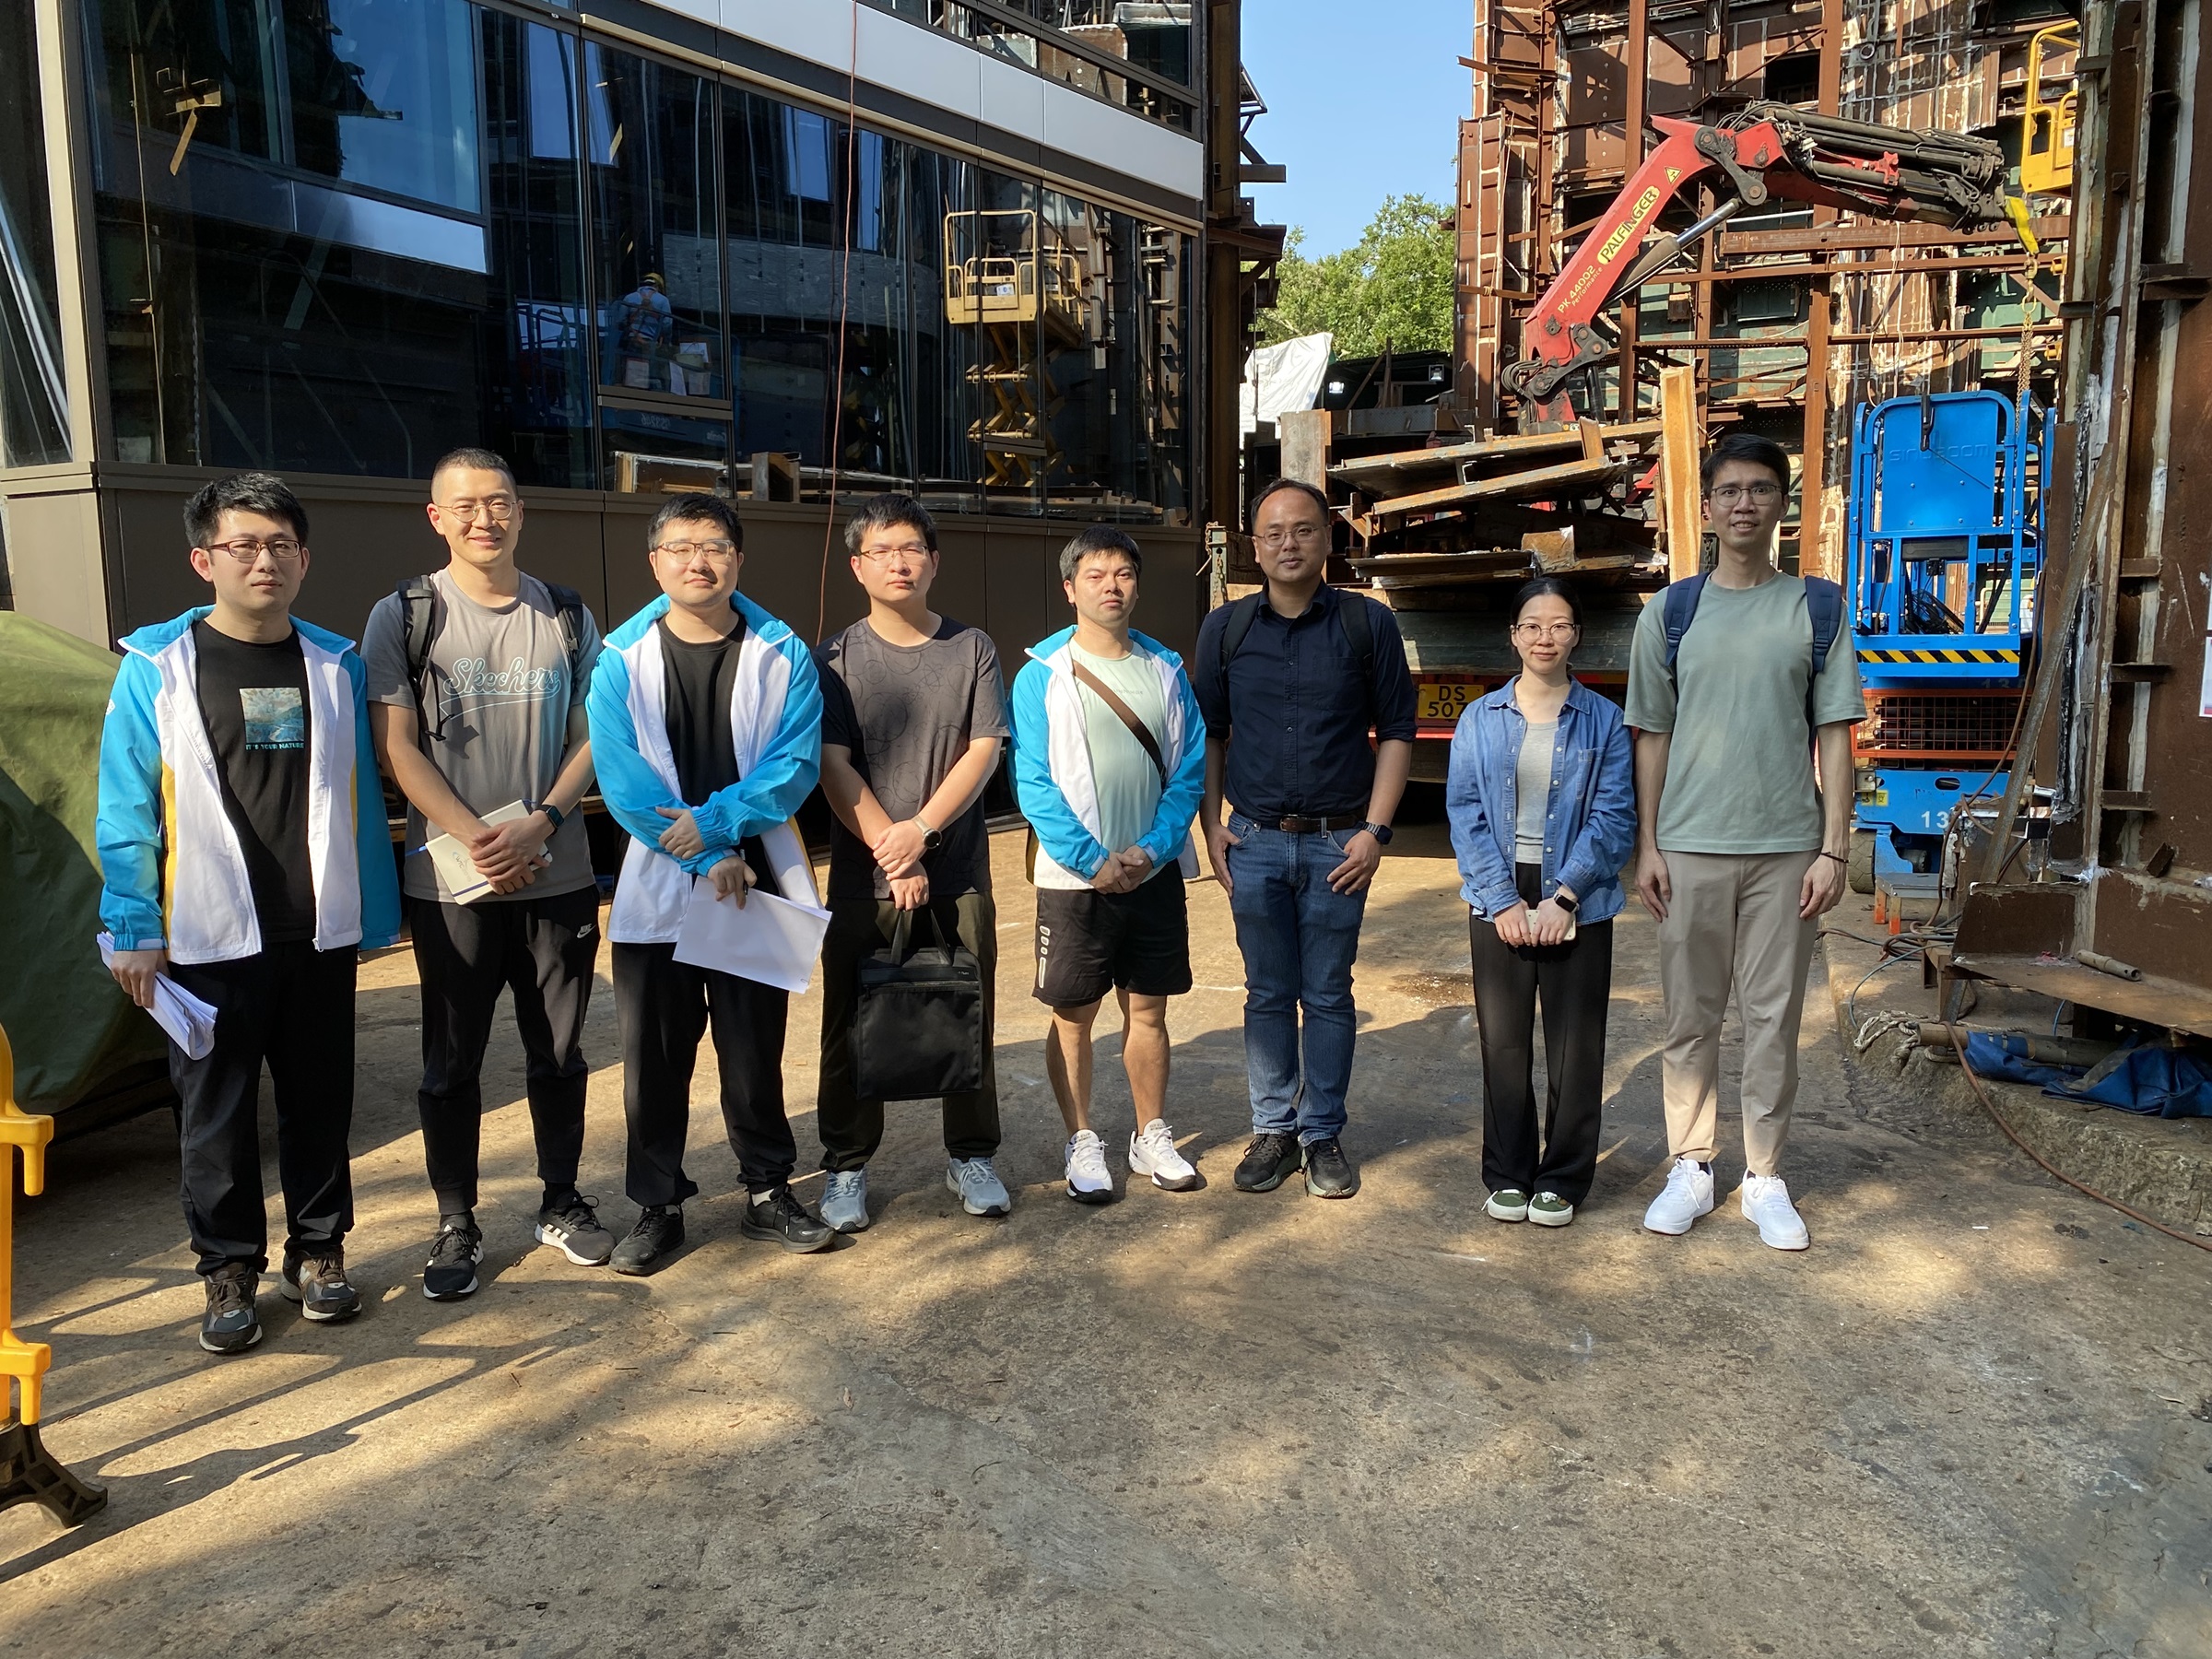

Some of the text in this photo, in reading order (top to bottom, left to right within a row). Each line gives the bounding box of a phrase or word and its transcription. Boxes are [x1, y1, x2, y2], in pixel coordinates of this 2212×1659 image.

[1600, 190, 1657, 262] PALFINGER
[1558, 265, 1595, 313] PK 44002
[442, 656, 561, 695] Skechers
[1439, 685, 1465, 701] DS
